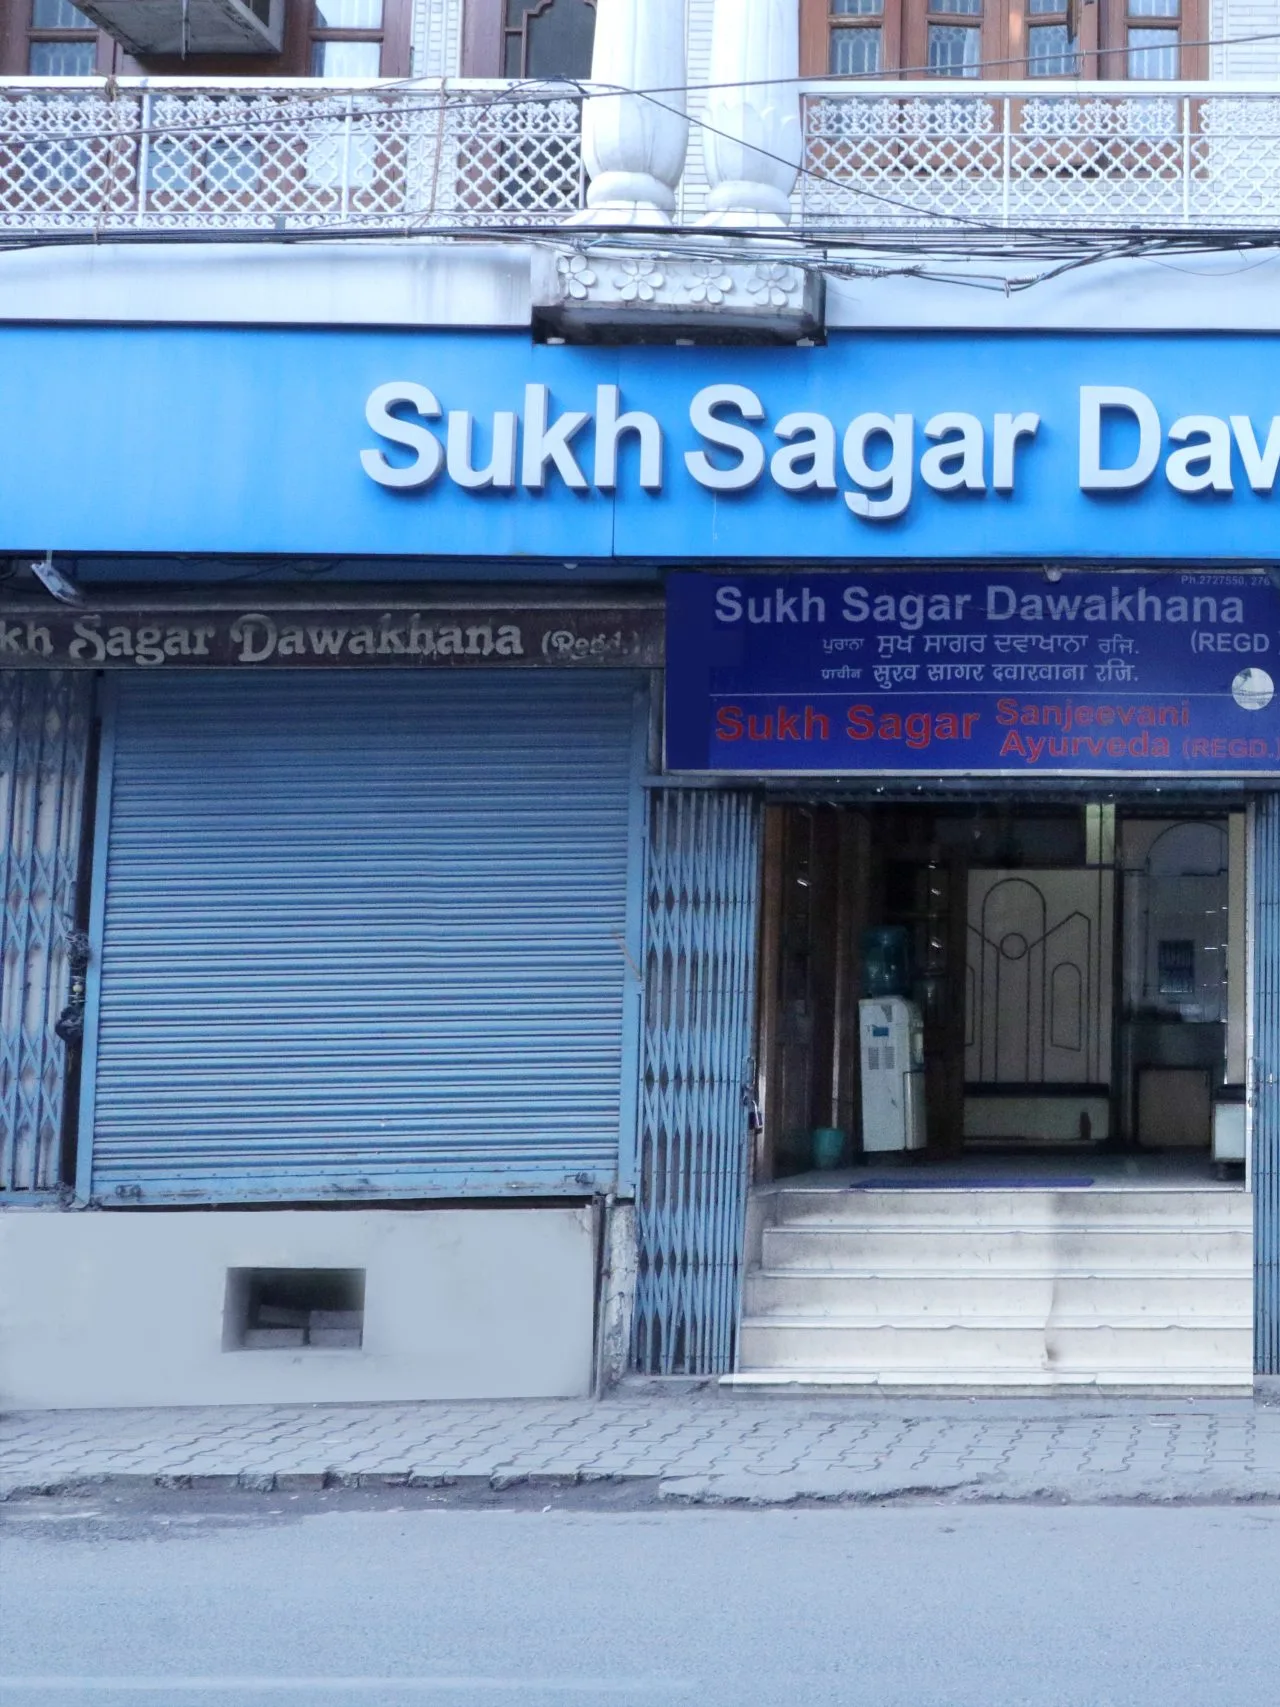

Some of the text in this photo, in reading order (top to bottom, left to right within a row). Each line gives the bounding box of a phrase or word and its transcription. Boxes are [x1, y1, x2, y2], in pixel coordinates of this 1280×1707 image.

[360, 381, 664, 489] Sukh
[683, 383, 1041, 520] Sagar
[714, 584, 1244, 629] Sukh Sagar Dawakhana
[69, 614, 217, 666] Sagar
[230, 612, 525, 663] Dawakhana
[876, 634, 916, 659] ਸੁਖ
[923, 633, 988, 654] ਸਾਗਰ
[871, 664, 921, 690] सुख
[926, 664, 986, 683] सागर
[991, 664, 1089, 683] दवाखाना
[715, 698, 1191, 749] Sukh Sagar Sanjeevani
[1000, 730, 1172, 764] Ayurveda
